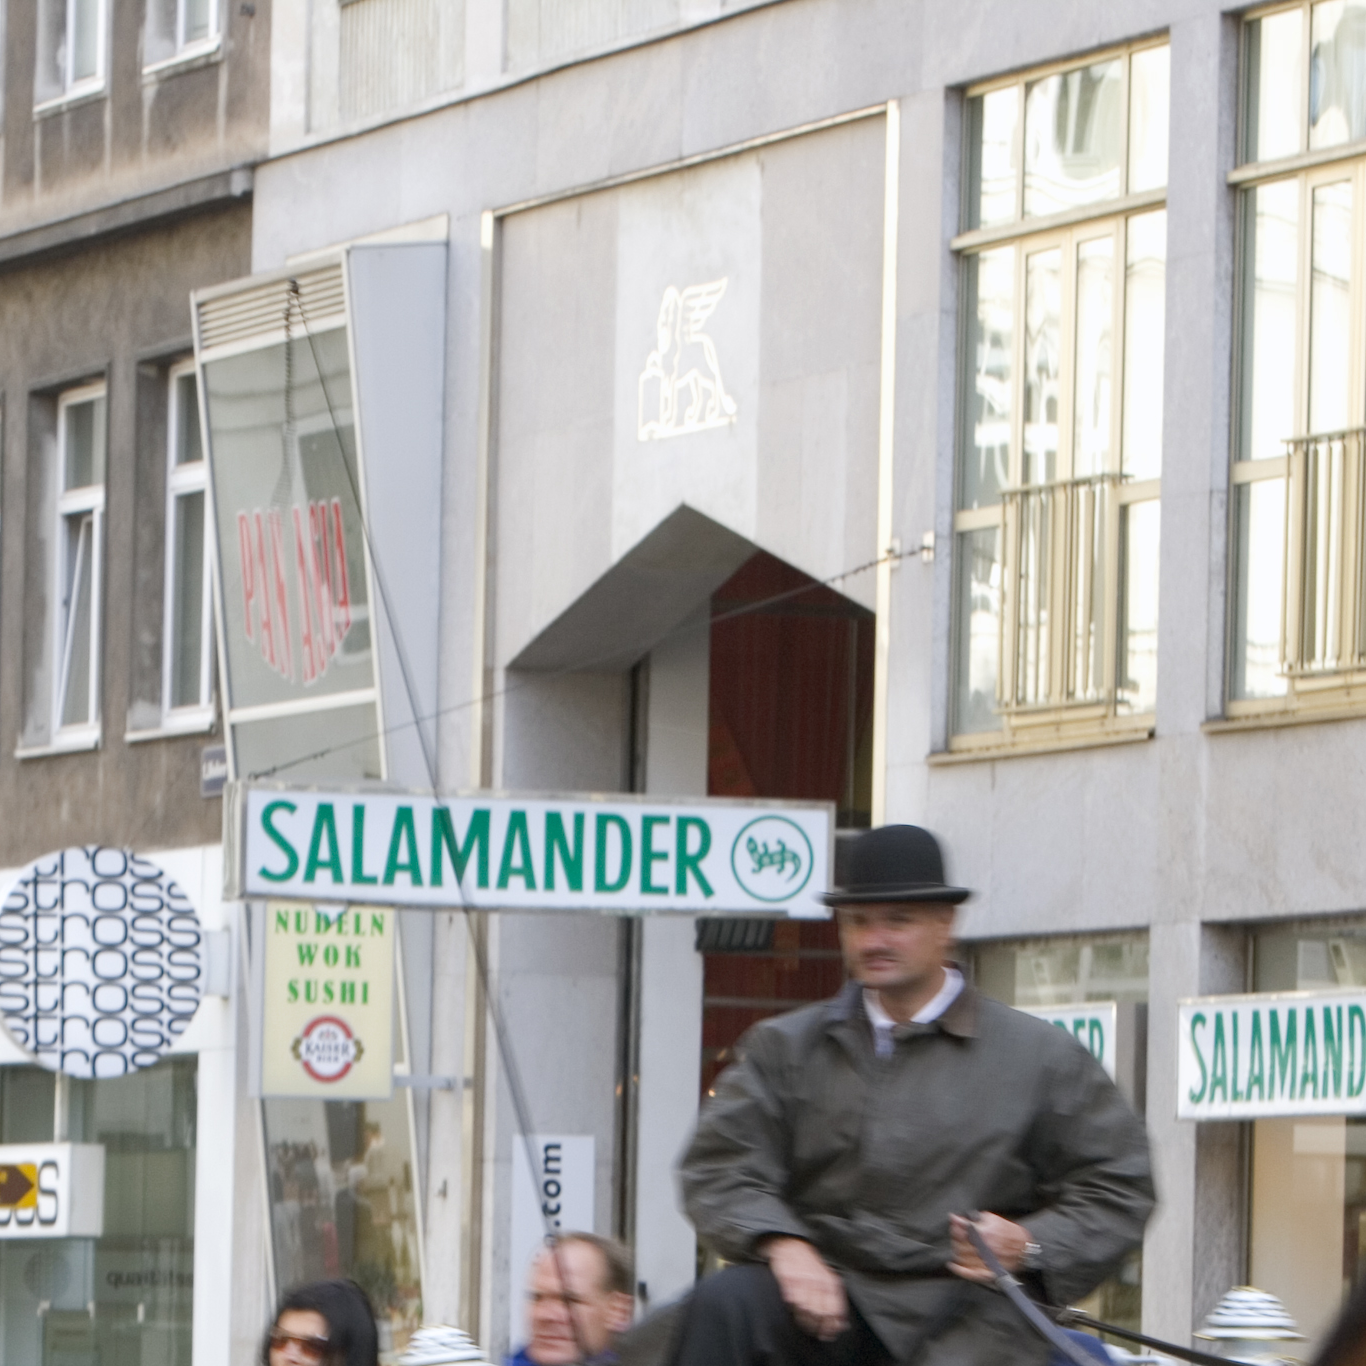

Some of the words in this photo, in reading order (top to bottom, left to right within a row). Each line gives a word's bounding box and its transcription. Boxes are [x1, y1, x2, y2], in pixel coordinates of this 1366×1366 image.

[257, 798, 716, 900] SALAMANDER
[275, 909, 385, 937] NUDELN
[296, 942, 362, 969] WOK
[287, 978, 370, 1005] SUSHI
